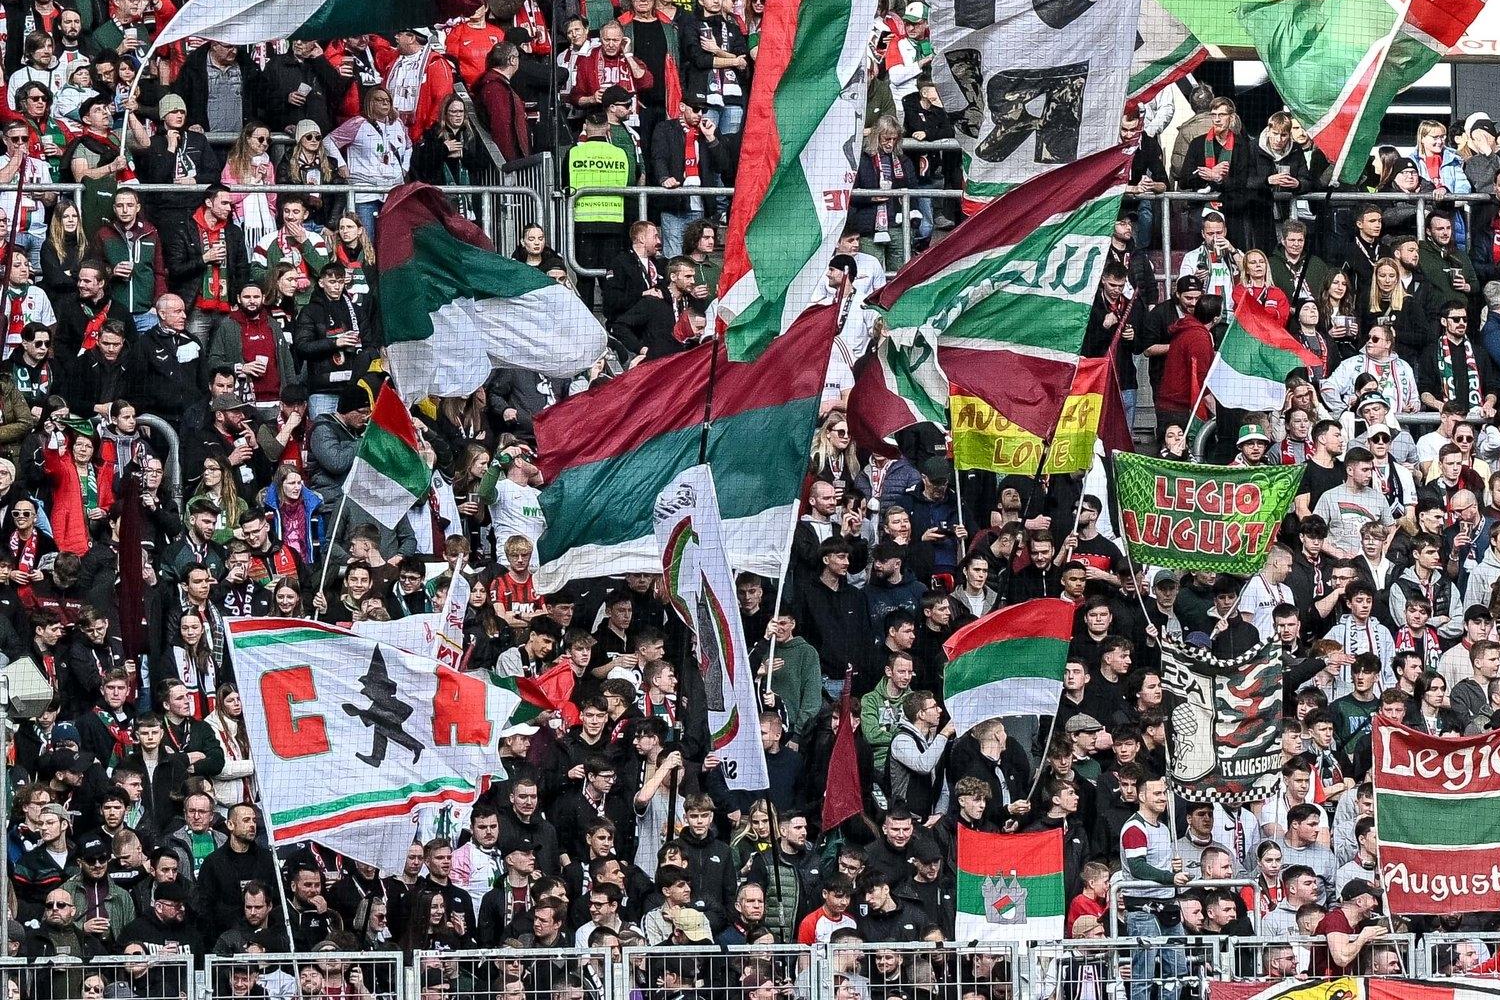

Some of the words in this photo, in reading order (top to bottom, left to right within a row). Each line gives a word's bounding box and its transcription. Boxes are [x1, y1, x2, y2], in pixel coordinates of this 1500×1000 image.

[589, 159, 625, 170] POWER
[994, 437, 1074, 470] LOVE
[1155, 476, 1262, 514] LEGIO
[512, 602, 535, 613] WWK
[432, 664, 494, 746] A
[1221, 760, 1235, 777] FC
